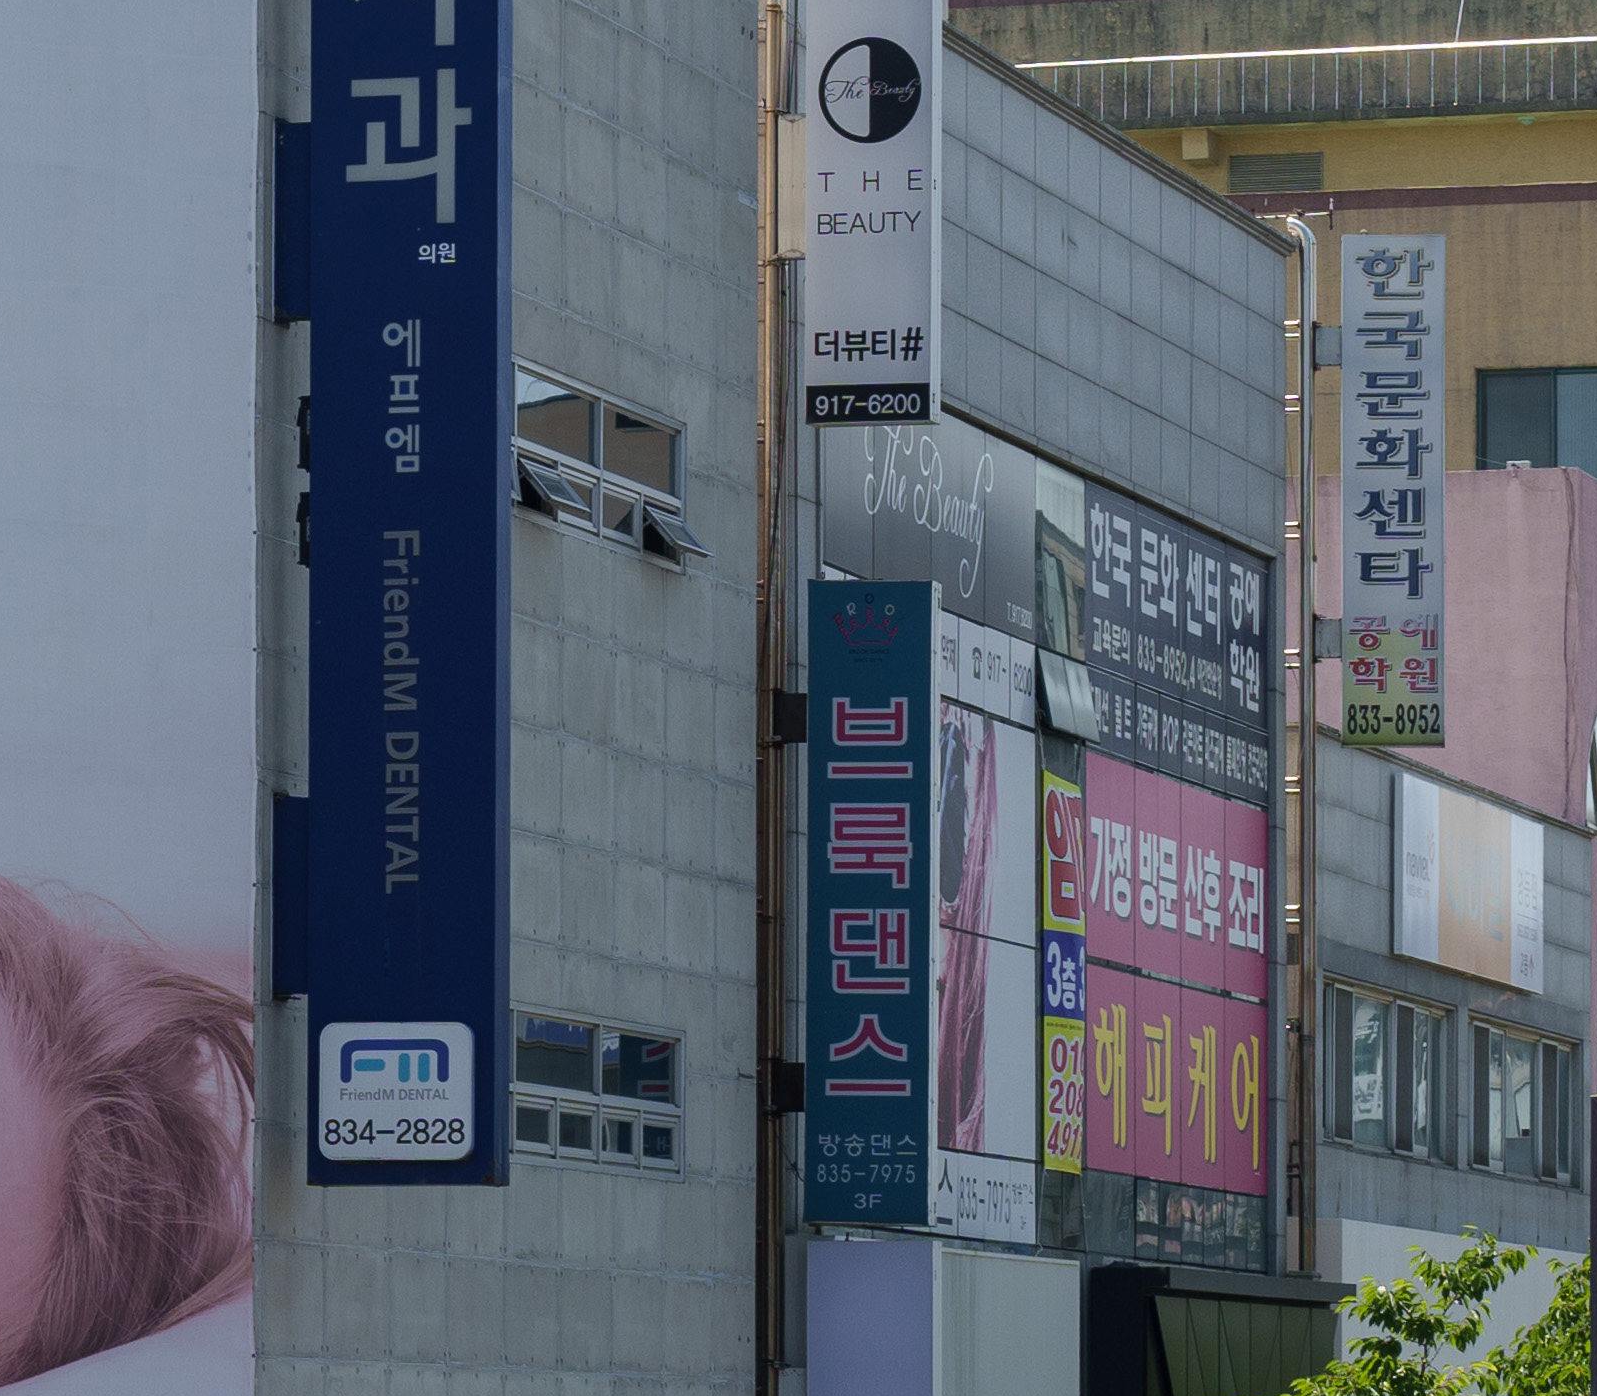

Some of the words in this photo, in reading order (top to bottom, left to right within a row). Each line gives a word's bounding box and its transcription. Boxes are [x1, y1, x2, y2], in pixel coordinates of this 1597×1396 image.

[825, 79, 865, 104] The
[817, 169, 924, 193] THE
[817, 211, 922, 235] BEAUTY
[418, 242, 456, 265] 의원
[814, 327, 924, 362] 더뷰티#
[382, 319, 421, 473] 에프엠
[815, 393, 921, 417] 917-6200
[1354, 246, 1433, 600] 한국문화센타
[1089, 502, 1133, 608] 한국
[1139, 527, 1179, 628] 문화
[1185, 548, 1222, 645] 센터
[1229, 562, 1261, 636] 공예
[383, 530, 420, 712] FriendM
[1092, 616, 1132, 666] 교육문의
[1348, 614, 1440, 652] 공예
[1229, 638, 1260, 713] 학원
[1348, 656, 1440, 694] 학원
[1162, 713, 1180, 755] POP
[1347, 703, 1441, 737] 833-8952
[385, 731, 420, 895] DENTAL
[826, 697, 913, 1097] 브룩댄스
[1090, 816, 1132, 918] 가정
[1139, 830, 1178, 931] 방문
[1183, 844, 1222, 943] 산후
[1228, 861, 1265, 955] 조리
[340, 1088, 395, 1101] FriendM
[398, 1088, 449, 1101] DENTAL
[1092, 1002, 1261, 1171] 해피케어
[324, 1118, 465, 1146] 834-2828
[818, 1132, 918, 1159] 방송댄스
[816, 1163, 917, 1185] 835-7975
[853, 1193, 882, 1209] 3F
[960, 1175, 1011, 1225] 835-7975
